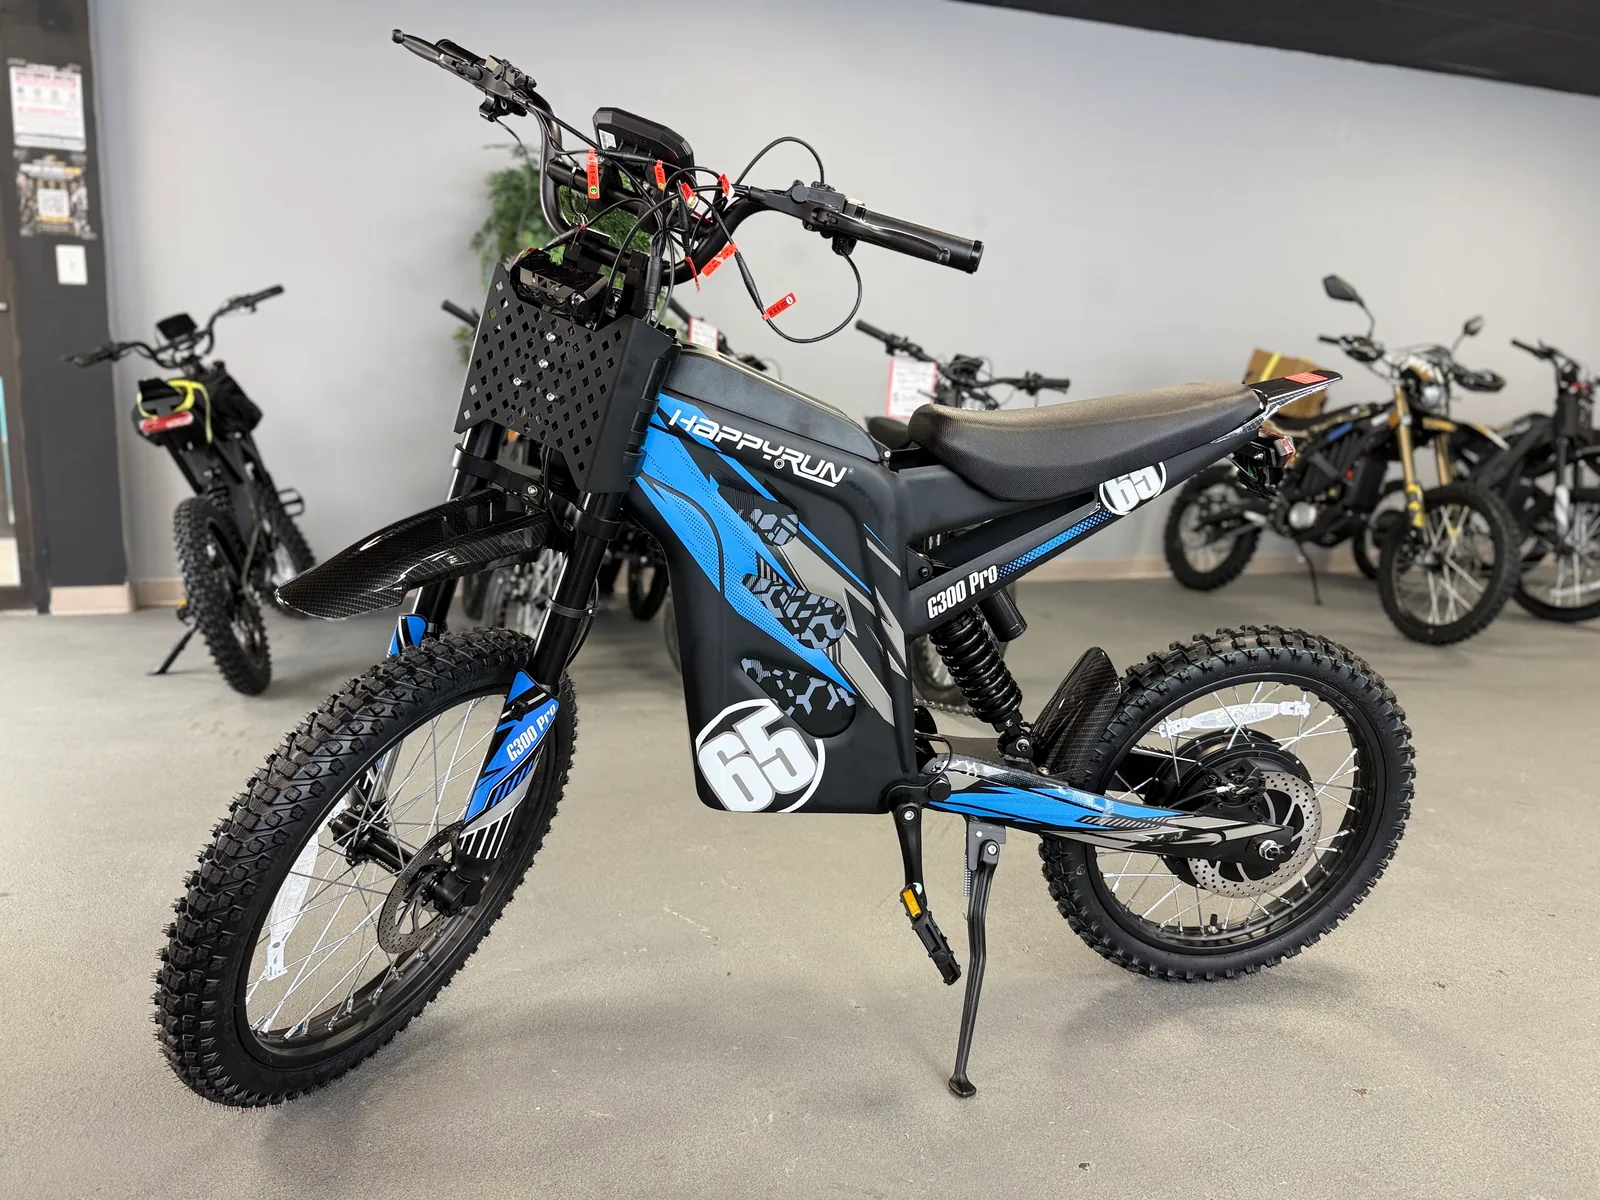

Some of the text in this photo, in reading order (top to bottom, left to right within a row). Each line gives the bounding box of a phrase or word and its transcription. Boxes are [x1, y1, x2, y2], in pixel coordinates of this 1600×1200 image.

[1104, 465, 1161, 513] 65
[927, 565, 998, 619] G300 Pro
[506, 703, 556, 762] G300 Pro
[698, 699, 818, 812] 65
